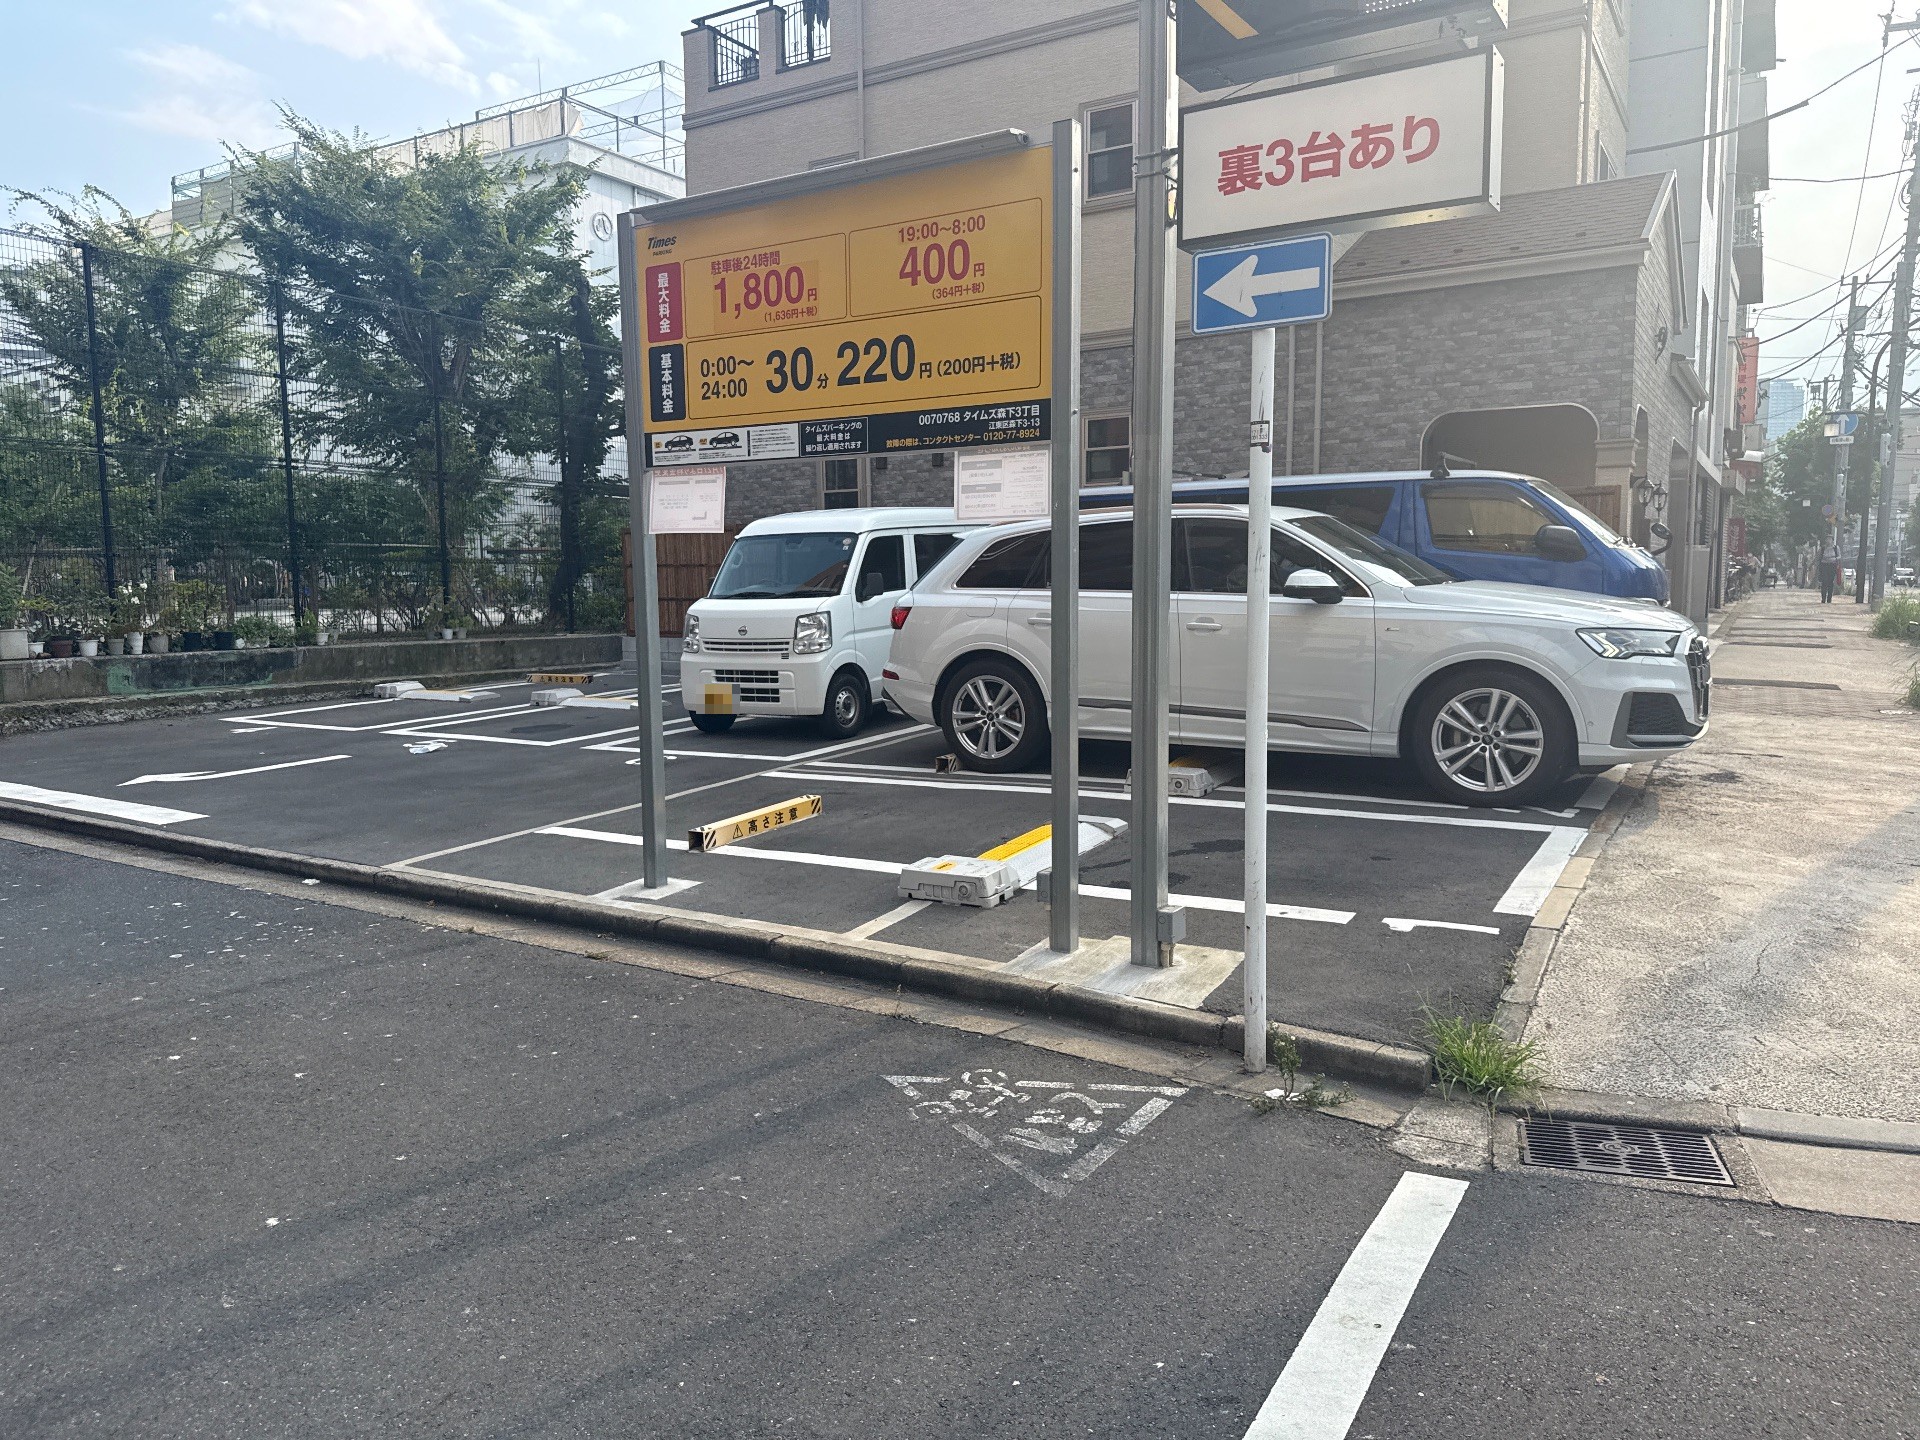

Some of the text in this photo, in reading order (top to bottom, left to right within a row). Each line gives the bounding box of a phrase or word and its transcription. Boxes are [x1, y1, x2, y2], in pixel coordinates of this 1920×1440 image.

[1217, 115, 1441, 196] 裏3台あり
[899, 214, 986, 243] 19:00〜8:00
[648, 236, 677, 250] Times
[652, 249, 672, 257] PARKING
[710, 250, 781, 275] 駐車後24時間
[899, 238, 985, 287] 400円
[714, 265, 818, 319] 1,800円
[932, 282, 985, 300] (364円+税)
[657, 272, 671, 334] 最大料金
[764, 306, 818, 323] (1,636円+税)
[700, 355, 755, 378] 0:00〜
[660, 352, 674, 414] 基本料金
[701, 377, 748, 401] 24:00
[918, 404, 1040, 426] 0070768 タイムズ森下3丁目
[988, 417, 1040, 430] 江東区森下3-13
[805, 421, 863, 434] タイムズパーキングの
[886, 428, 1040, 448] 故障の際は、コンタクトセンター 0120-77-8924
[748, 807, 798, 834] 高さ注意
